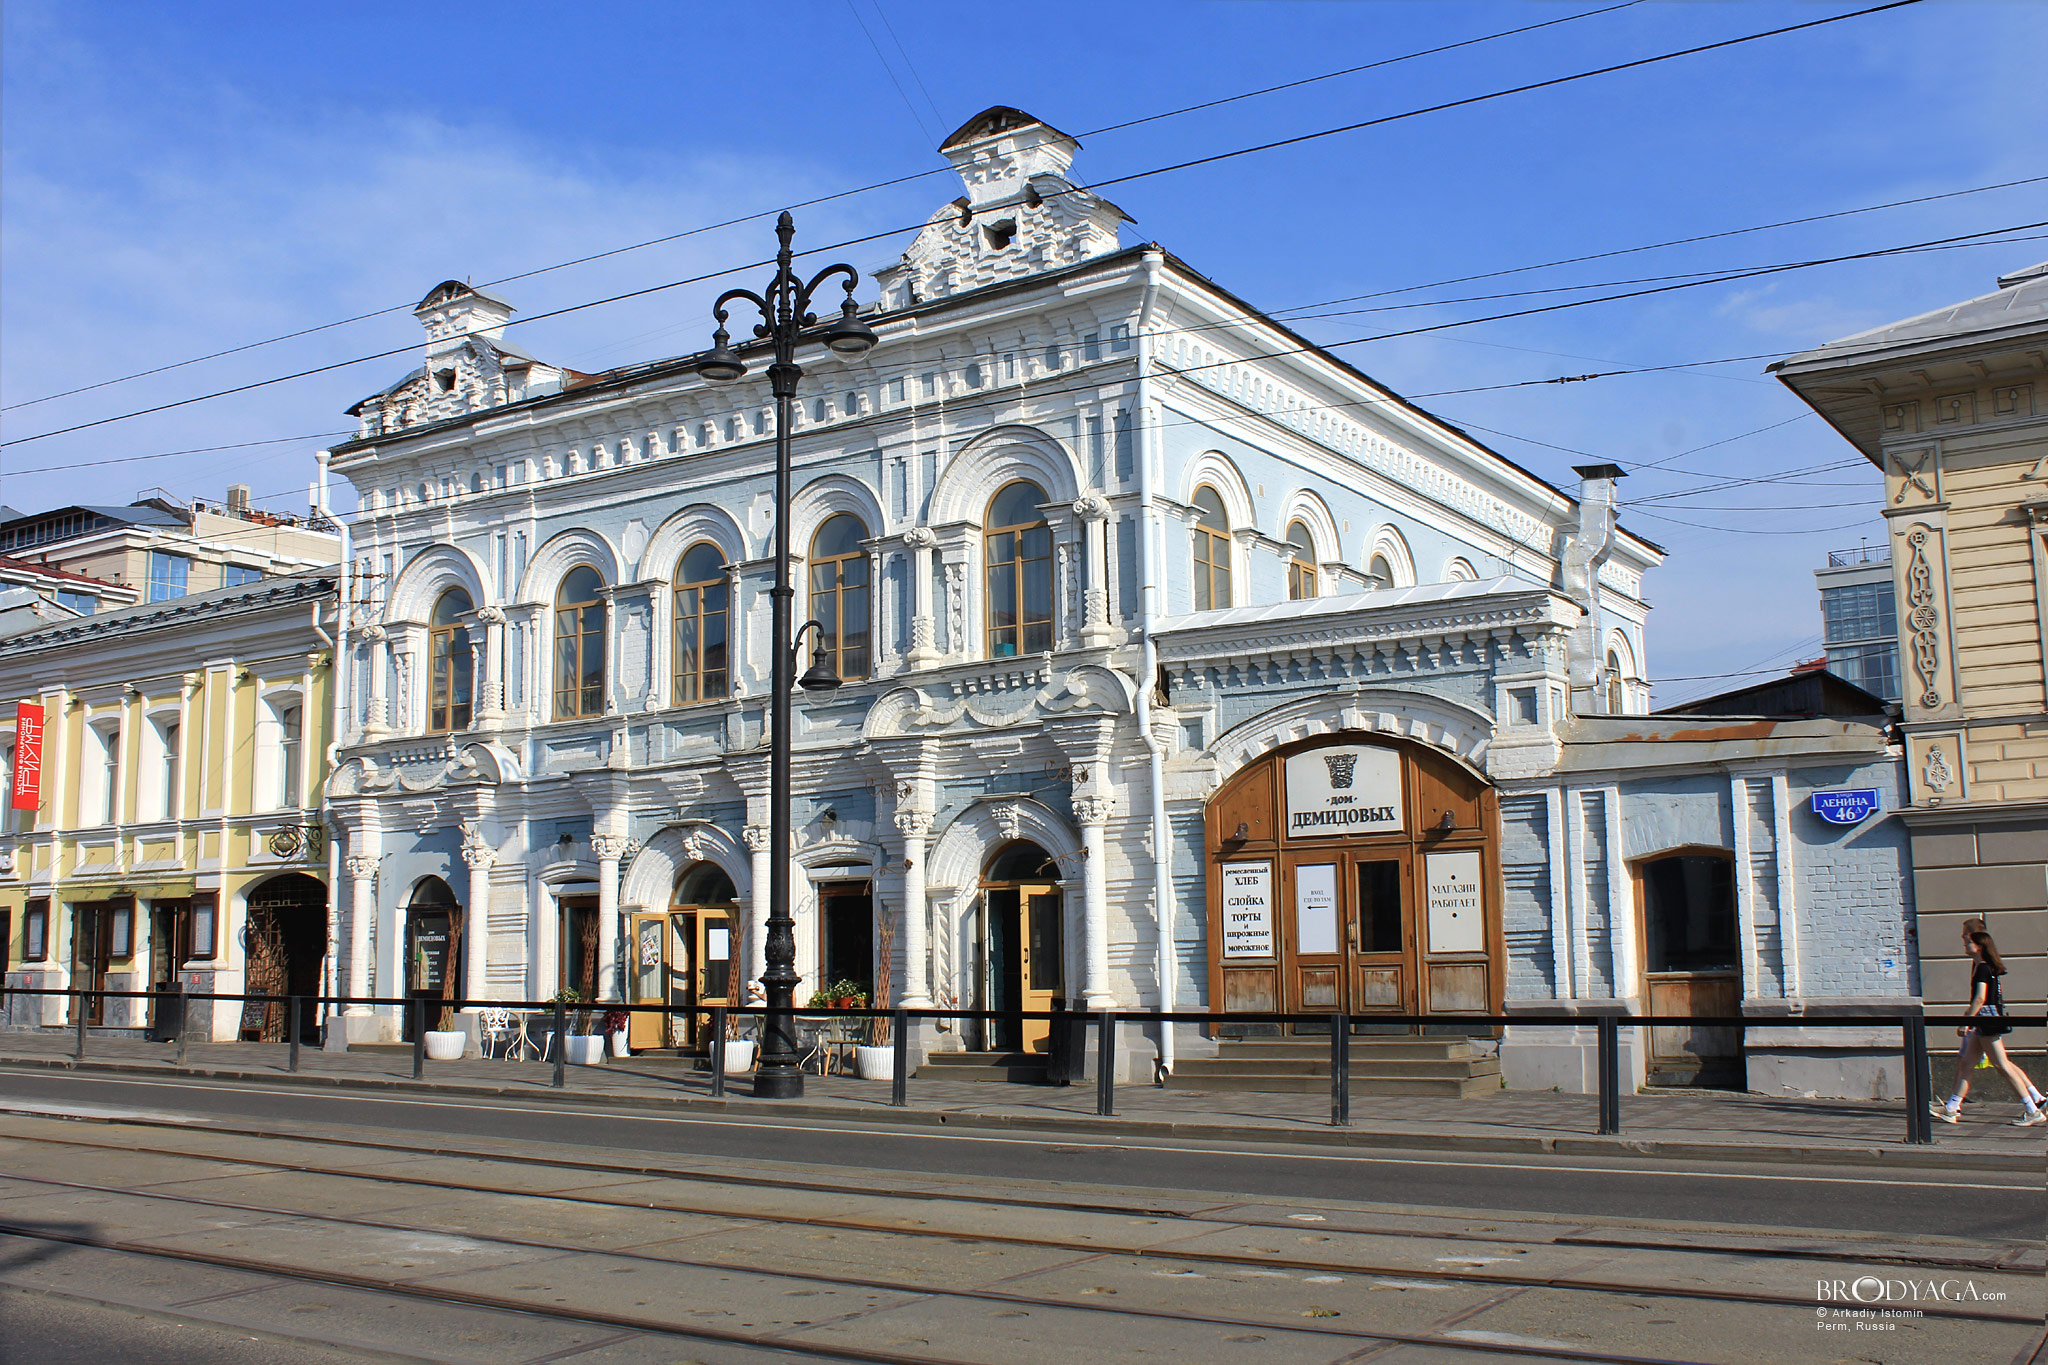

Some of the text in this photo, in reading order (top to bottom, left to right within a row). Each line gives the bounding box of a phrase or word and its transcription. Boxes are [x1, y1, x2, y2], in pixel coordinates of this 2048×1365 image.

[21, 717, 42, 796] ТРИУМФ
[1821, 797, 1868, 807] ЛЕНИНА
[1292, 806, 1395, 829] ДЕМИДОВЫХ
[1225, 867, 1269, 877] ремесленный
[1234, 876, 1259, 886] ХЛЕБ
[1432, 884, 1476, 894] МАГАЗИН
[1228, 895, 1265, 906] СЛОЙКА
[1431, 899, 1477, 908] РАБОТАЕТ
[1231, 913, 1262, 922] ТОРТЫ
[1226, 930, 1270, 939] пирожные
[1228, 944, 1270, 952] МОРОЖЕНОЕ
